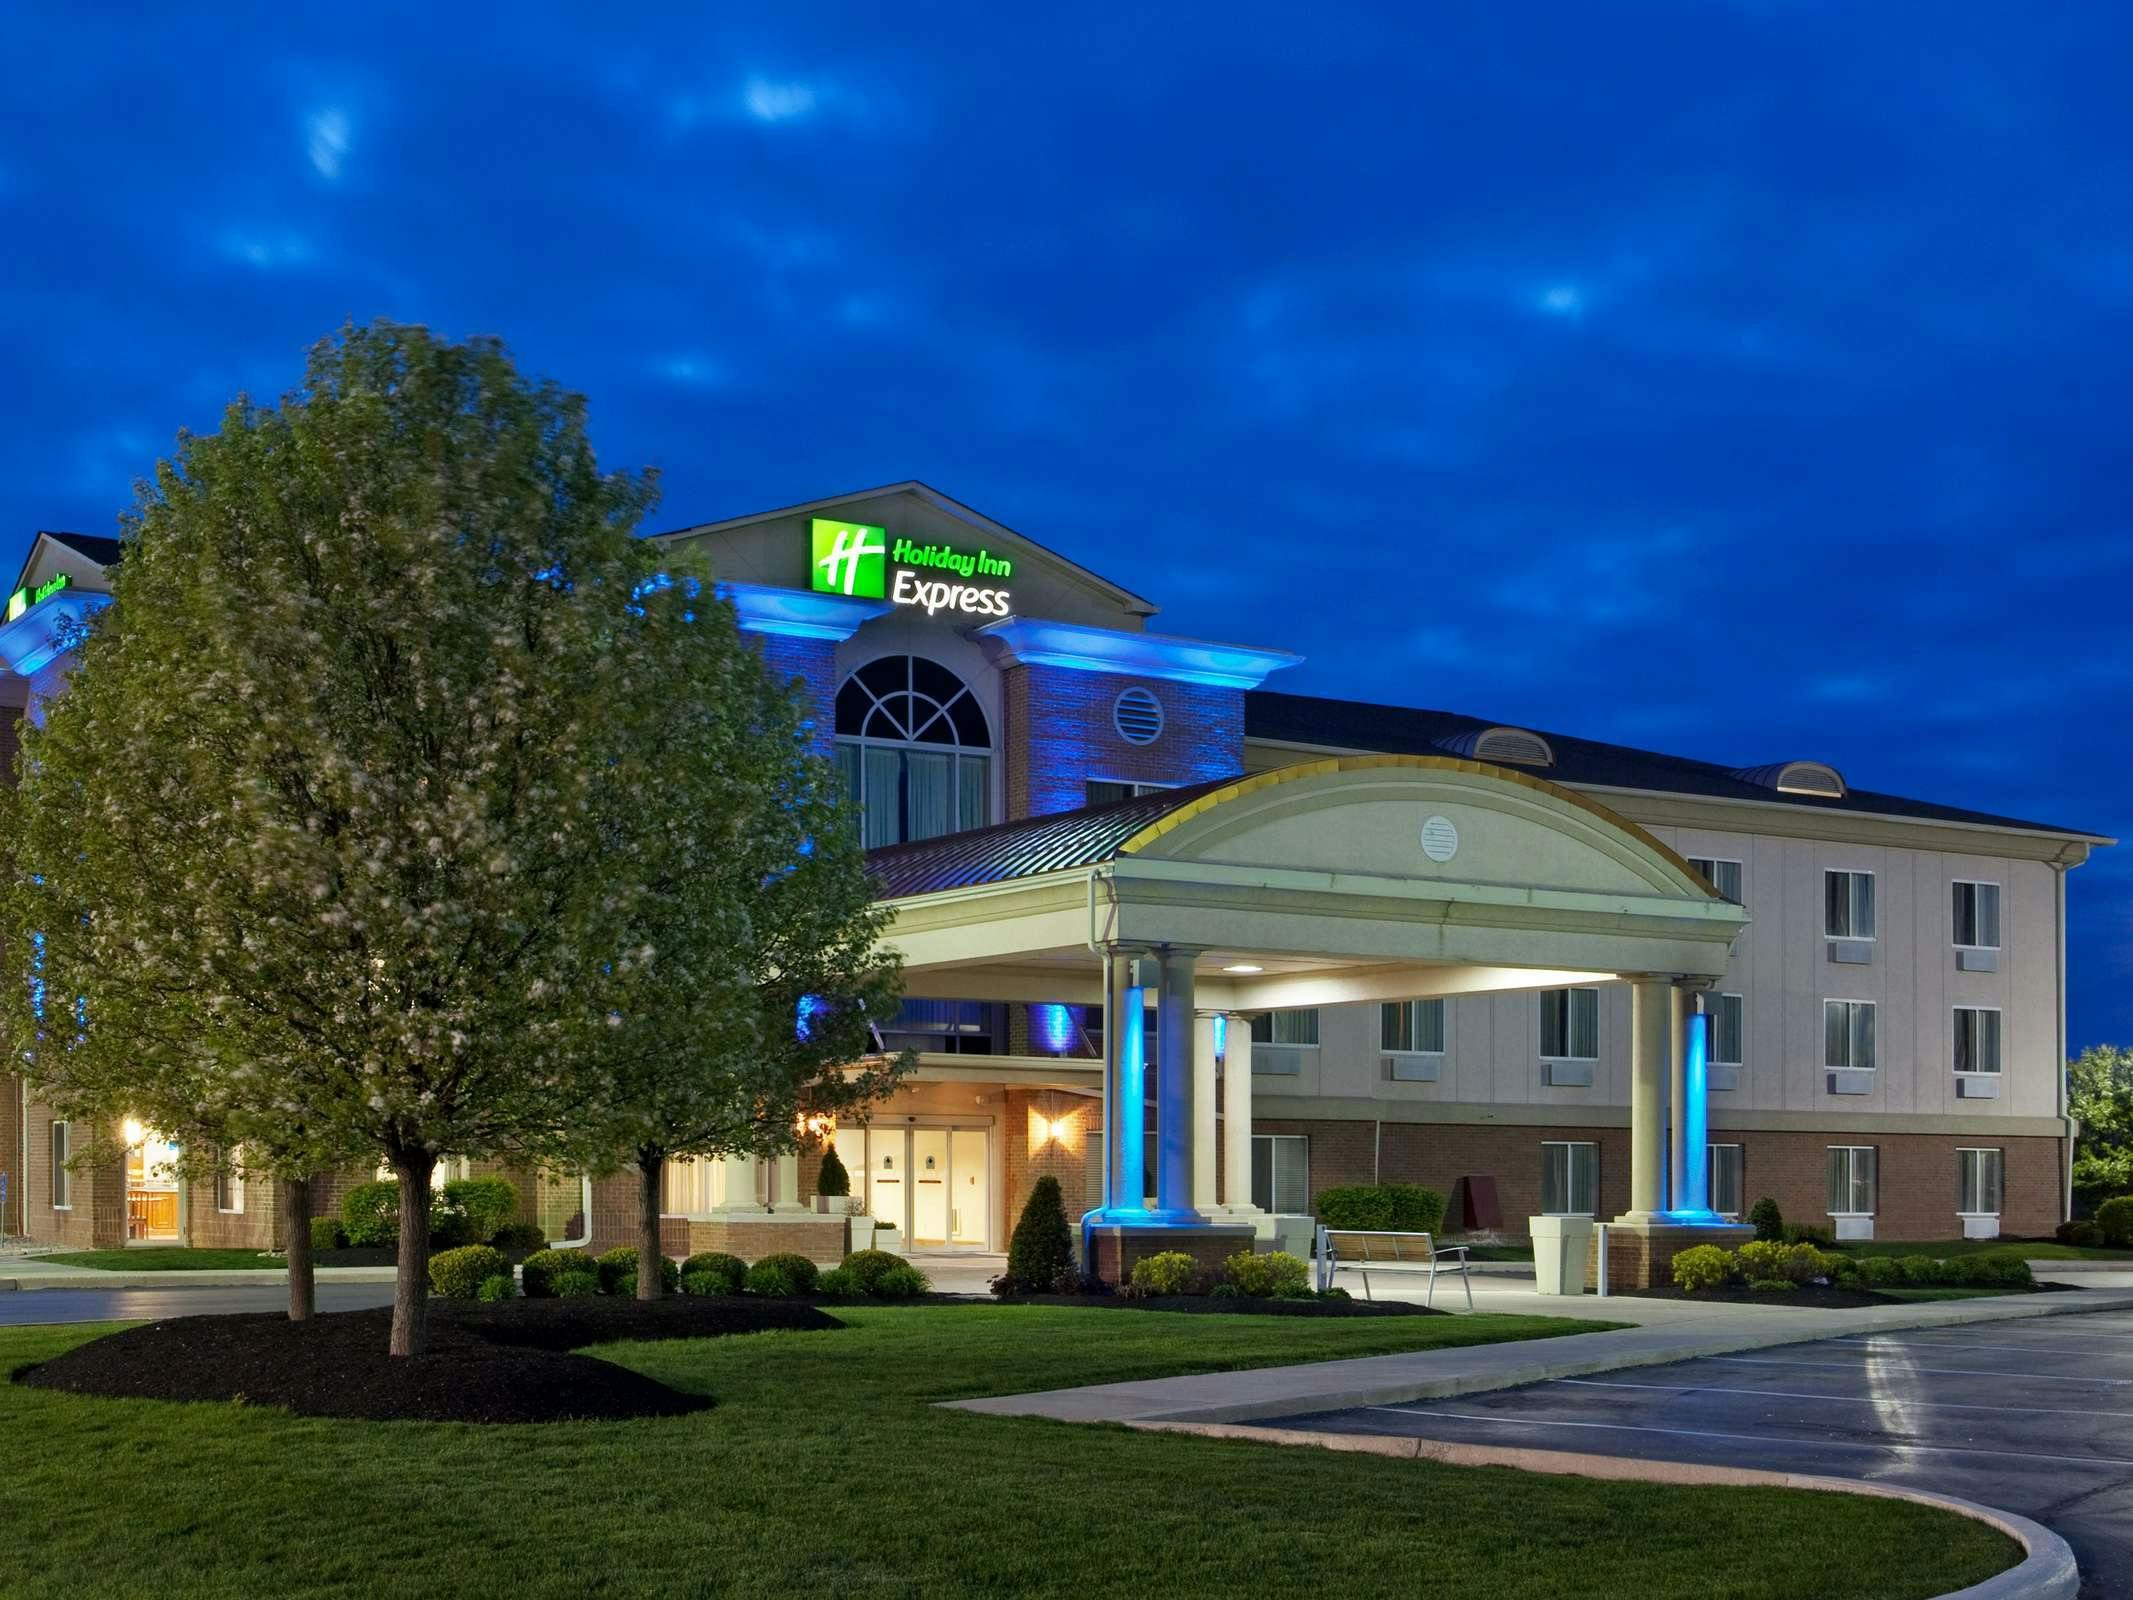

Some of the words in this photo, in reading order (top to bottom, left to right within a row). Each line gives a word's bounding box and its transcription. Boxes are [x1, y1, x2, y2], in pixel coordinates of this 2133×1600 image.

[893, 539, 976, 576] Holiday
[977, 550, 1011, 577] Inn
[893, 571, 1010, 616] Express
